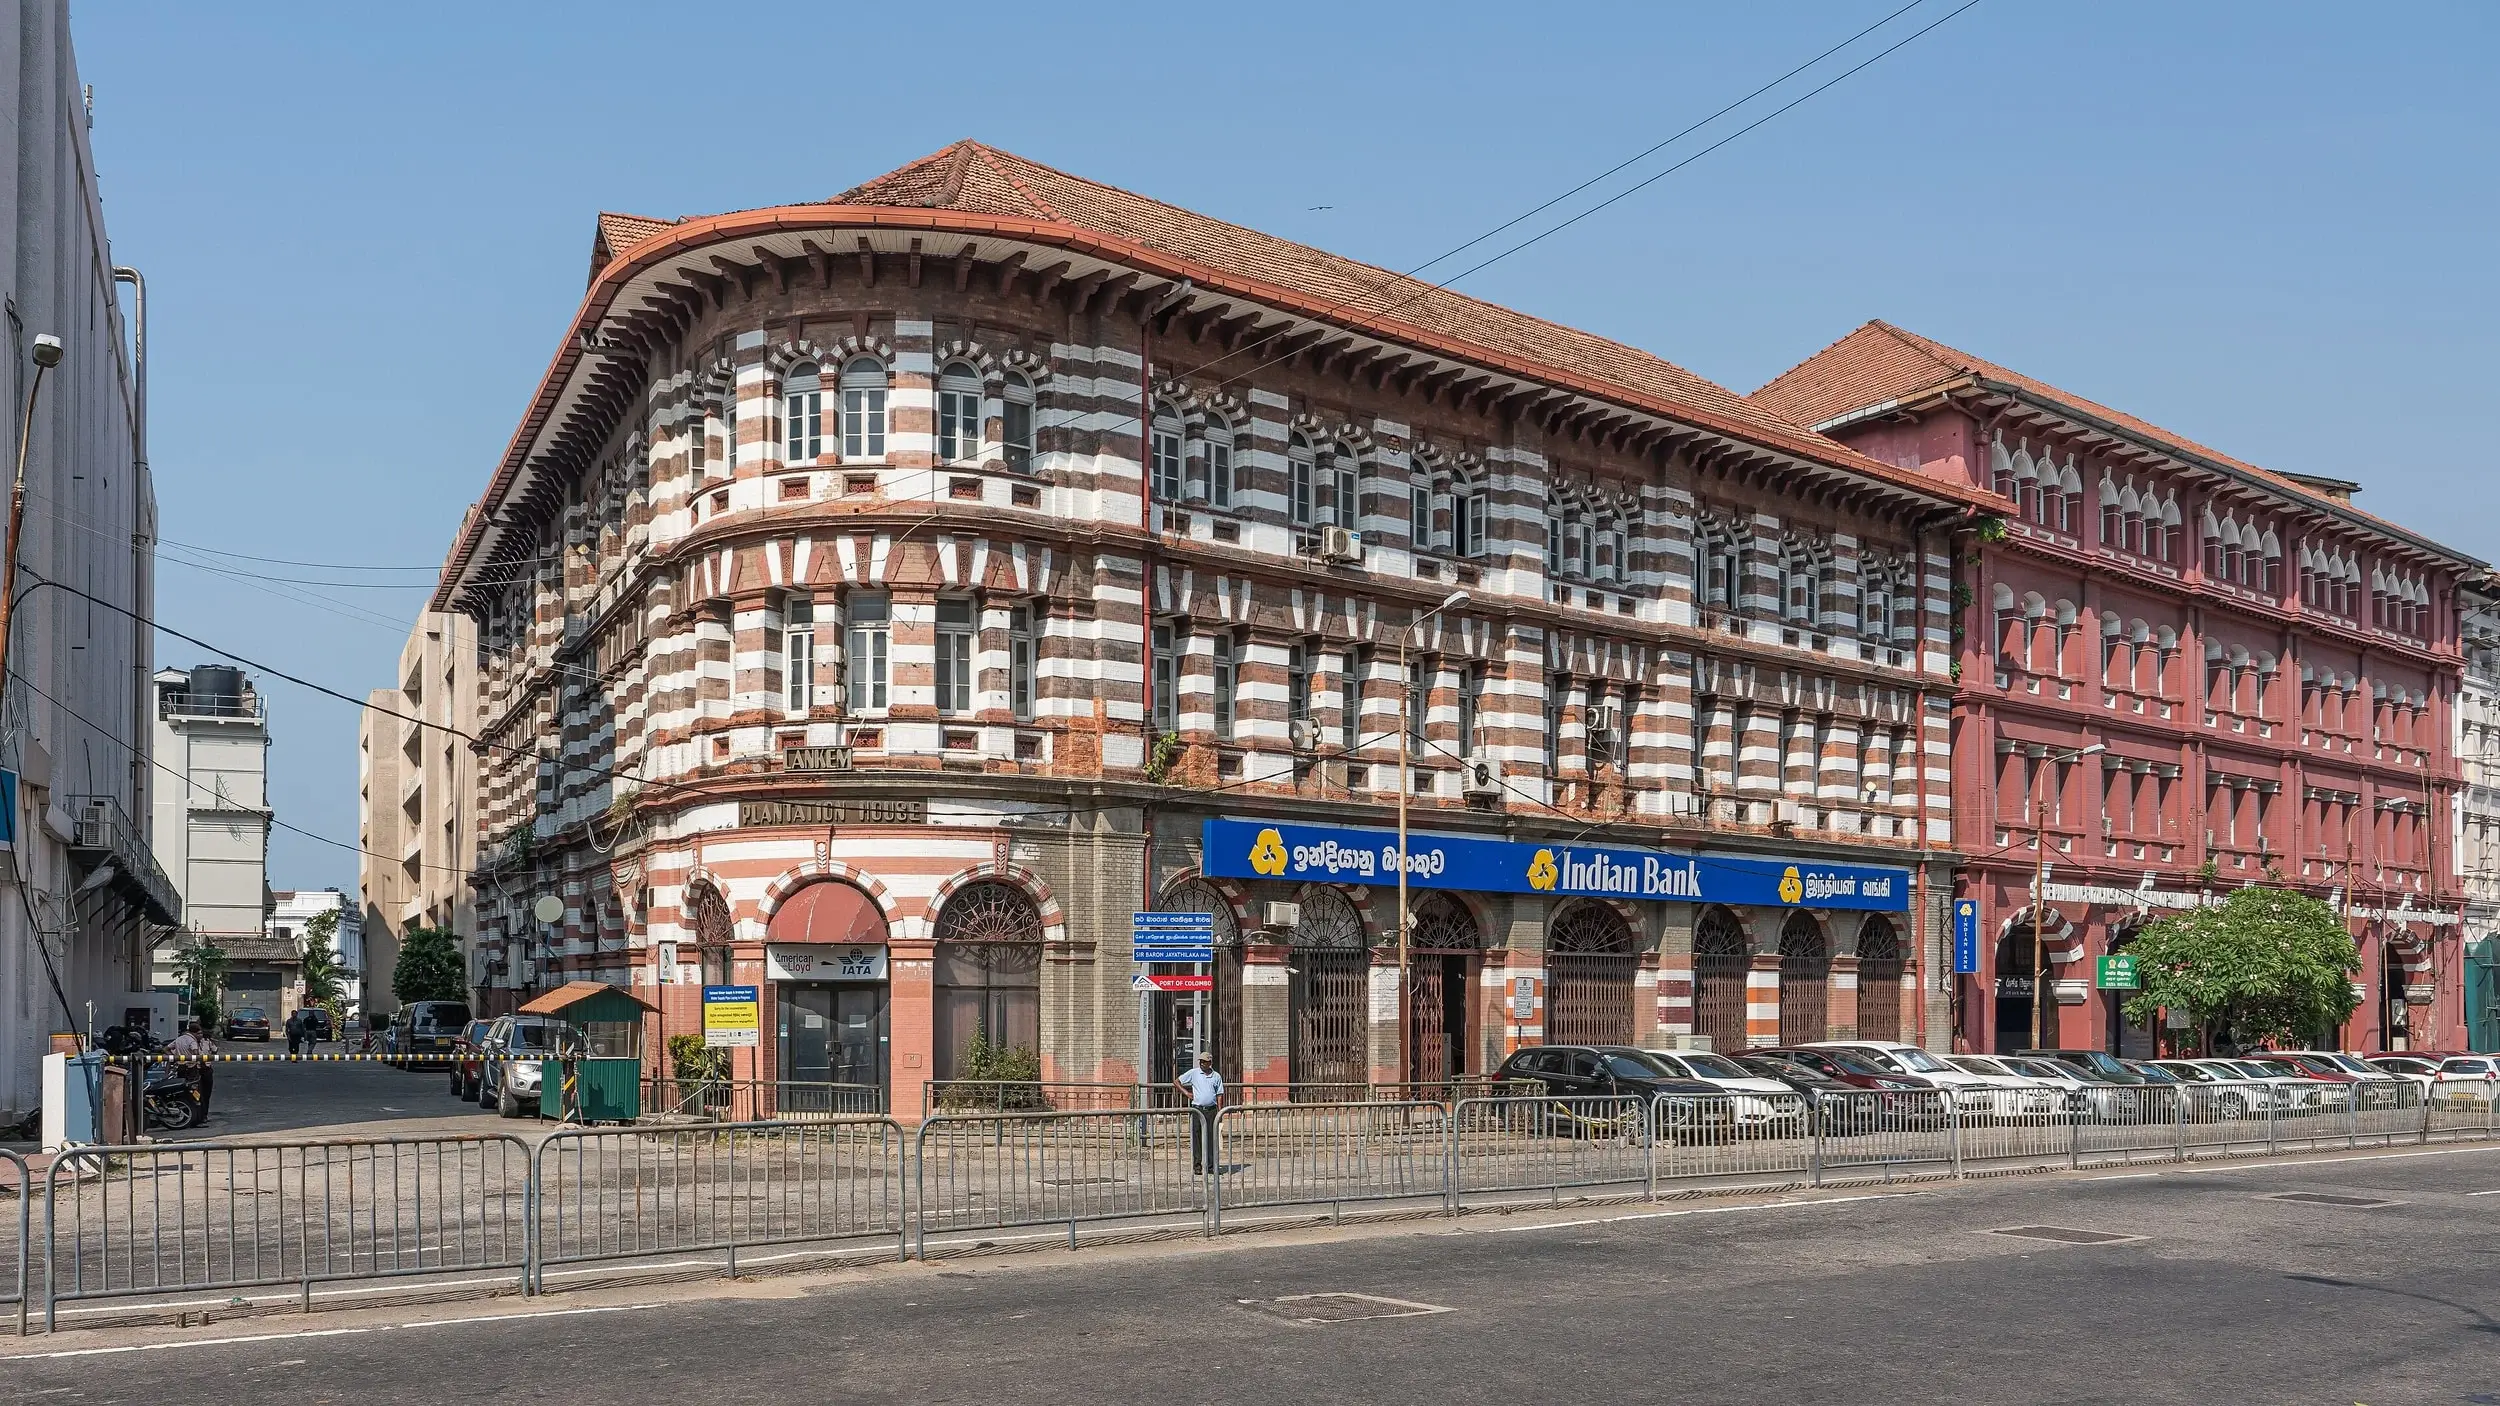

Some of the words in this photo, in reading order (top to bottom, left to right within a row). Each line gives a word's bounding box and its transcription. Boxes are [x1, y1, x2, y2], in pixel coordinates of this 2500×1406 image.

[785, 749, 851, 769] LANKEM
[743, 801, 845, 825] PLANTATION
[859, 801, 921, 823] HOUSE
[1293, 840, 1375, 877] ඉන්දියානු
[1562, 852, 1638, 893] Indian
[1643, 857, 1702, 896] Bank
[1805, 872, 1855, 899] இந்தியன்
[1862, 878, 1890, 897] வங்கி
[775, 953, 814, 963] American
[788, 962, 811, 973] Lloyd
[842, 966, 872, 975] IATA
